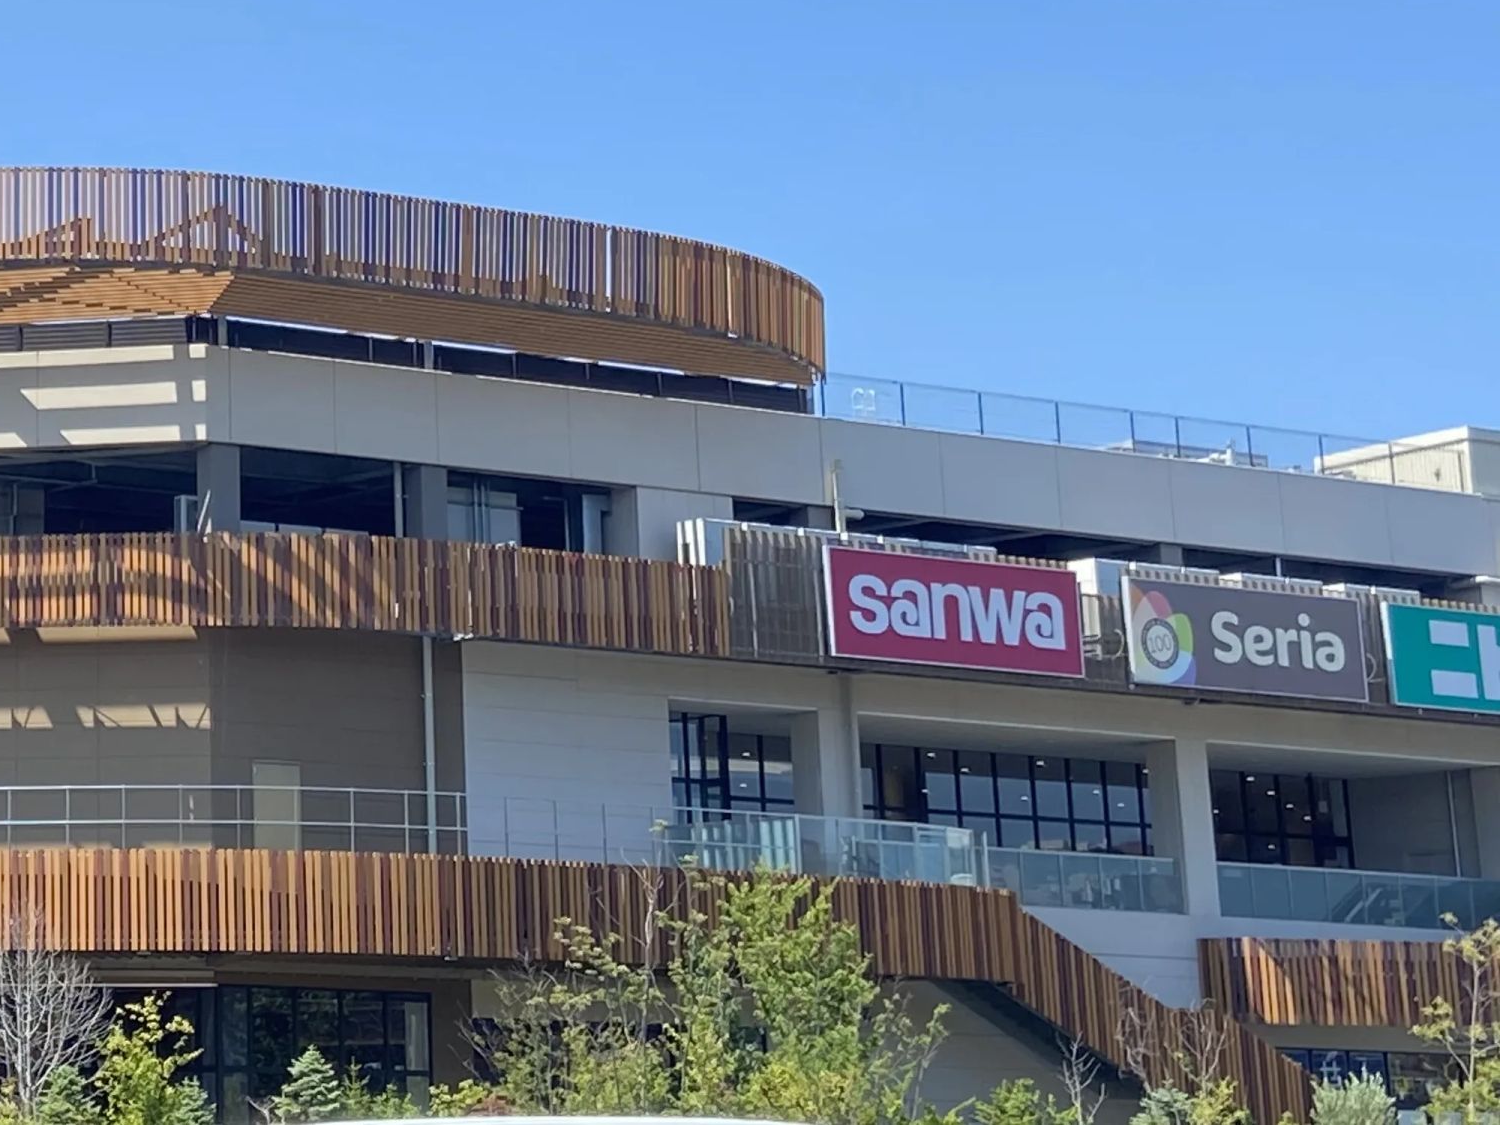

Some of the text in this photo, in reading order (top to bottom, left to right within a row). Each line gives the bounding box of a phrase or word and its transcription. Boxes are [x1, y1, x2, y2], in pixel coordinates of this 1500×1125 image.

[848, 574, 1066, 650] sanwa
[1211, 610, 1345, 672] Seria
[1148, 634, 1172, 653] 100
